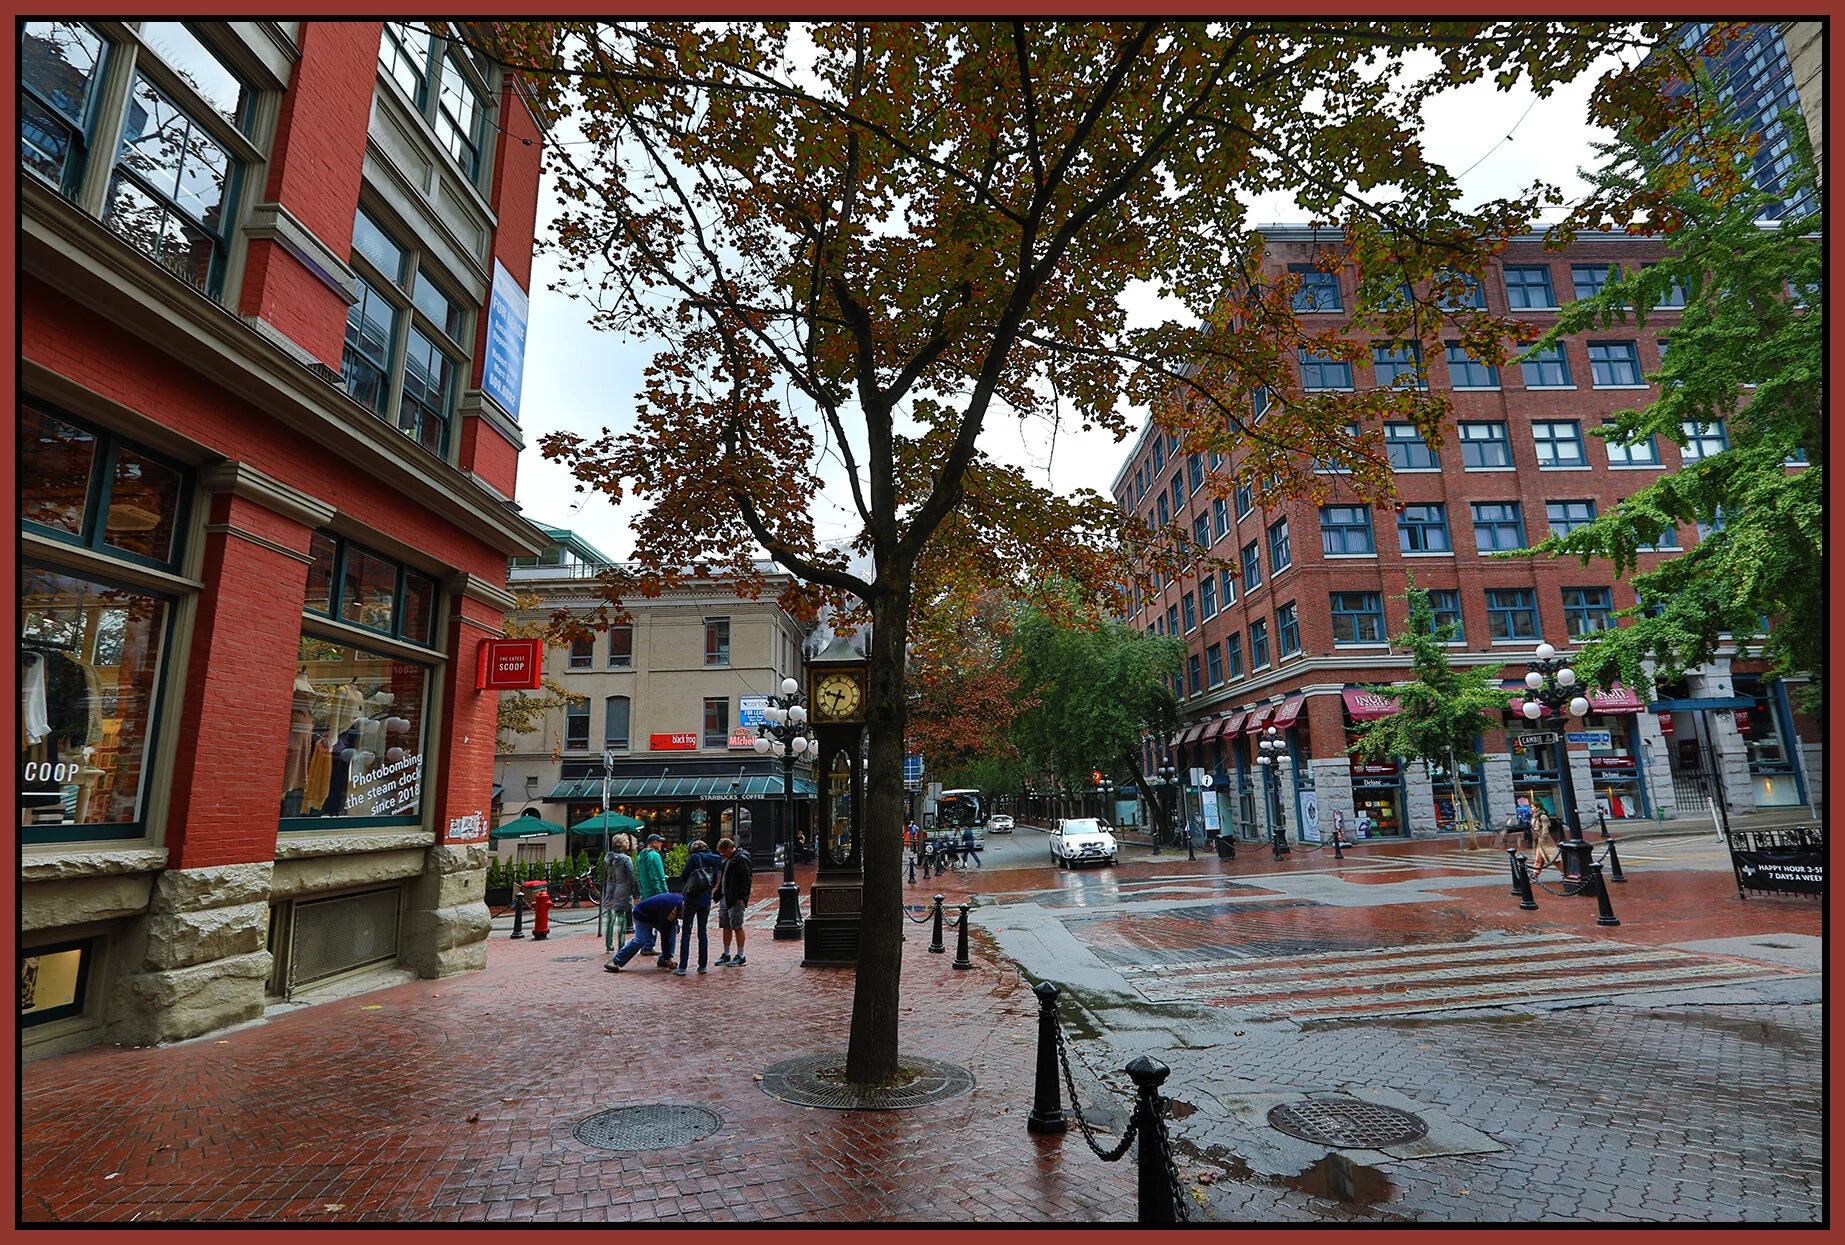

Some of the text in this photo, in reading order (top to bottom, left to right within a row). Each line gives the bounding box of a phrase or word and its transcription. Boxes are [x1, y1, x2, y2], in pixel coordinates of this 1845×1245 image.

[493, 296, 506, 319] FOR
[507, 311, 525, 341] LEASE
[498, 662, 525, 671] SCOOP
[672, 734, 697, 746] black frog
[24, 761, 80, 782] COOP
[352, 753, 423, 789] Photobombing
[346, 767, 421, 809] the steam clock
[371, 797, 396, 816] since
[398, 783, 420, 804] 2018
